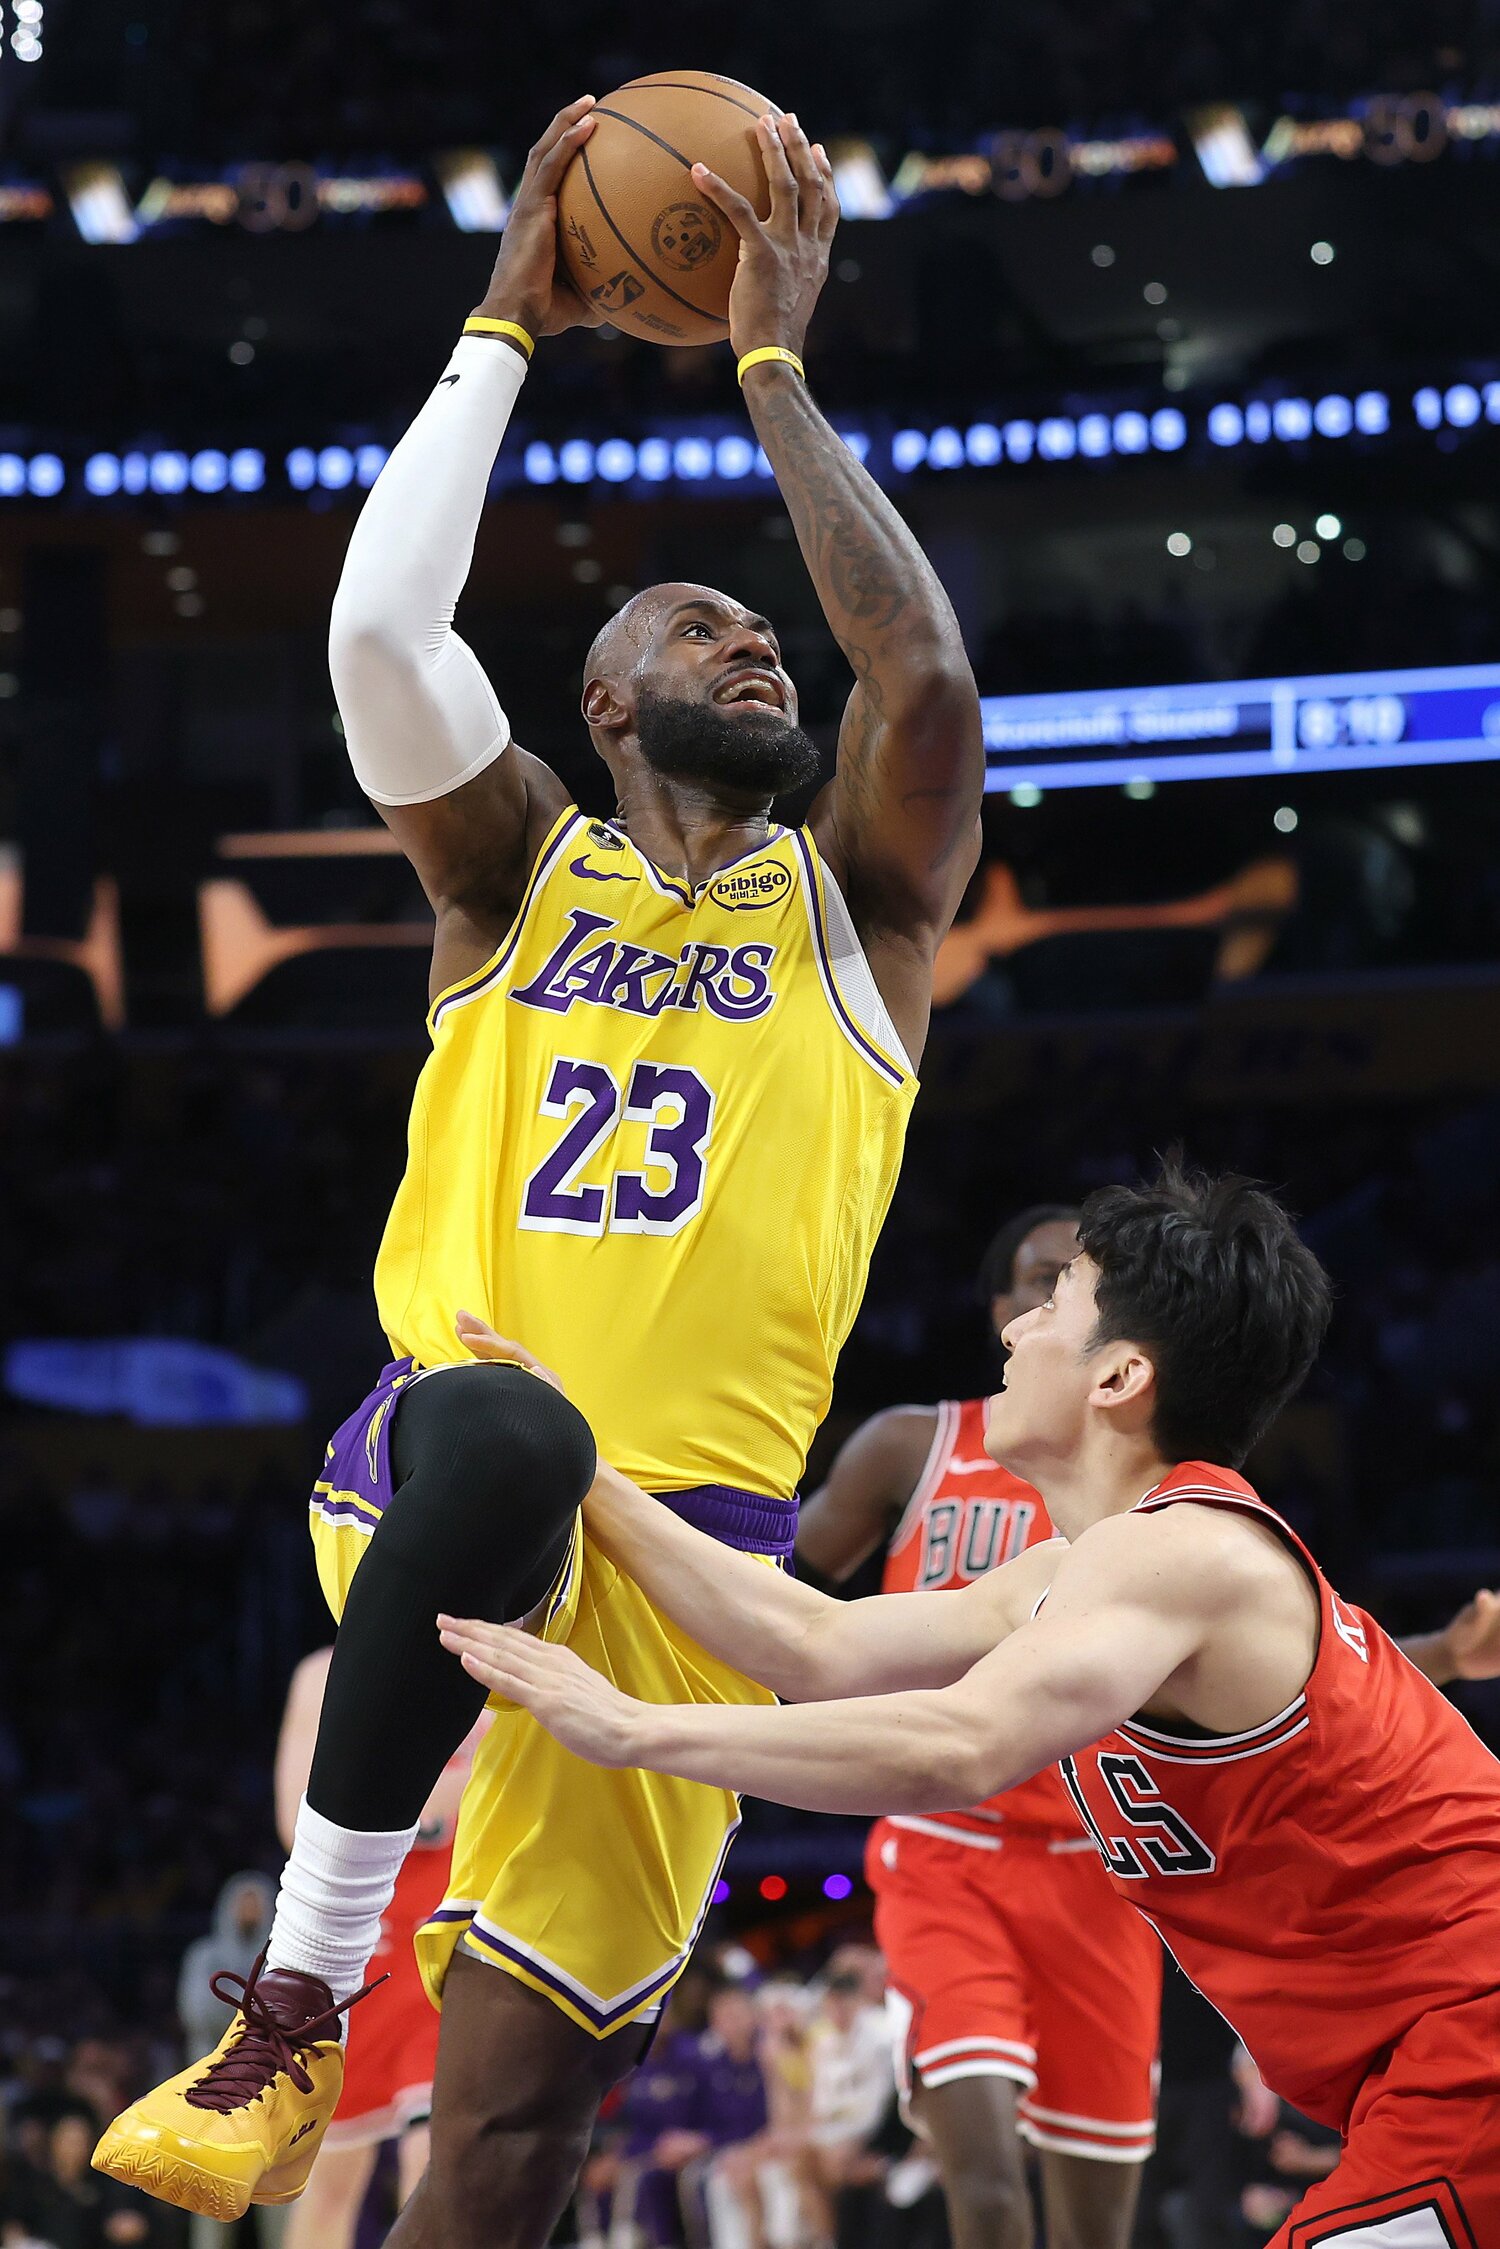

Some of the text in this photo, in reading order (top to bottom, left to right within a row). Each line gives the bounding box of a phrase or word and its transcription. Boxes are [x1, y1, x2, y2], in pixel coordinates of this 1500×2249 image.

[717, 872, 787, 894] bibigo
[730, 889, 759, 900] 비비고
[505, 906, 778, 1024] LAKERS
[517, 1055, 717, 1237] 23
[1058, 1751, 1217, 1880] LS
